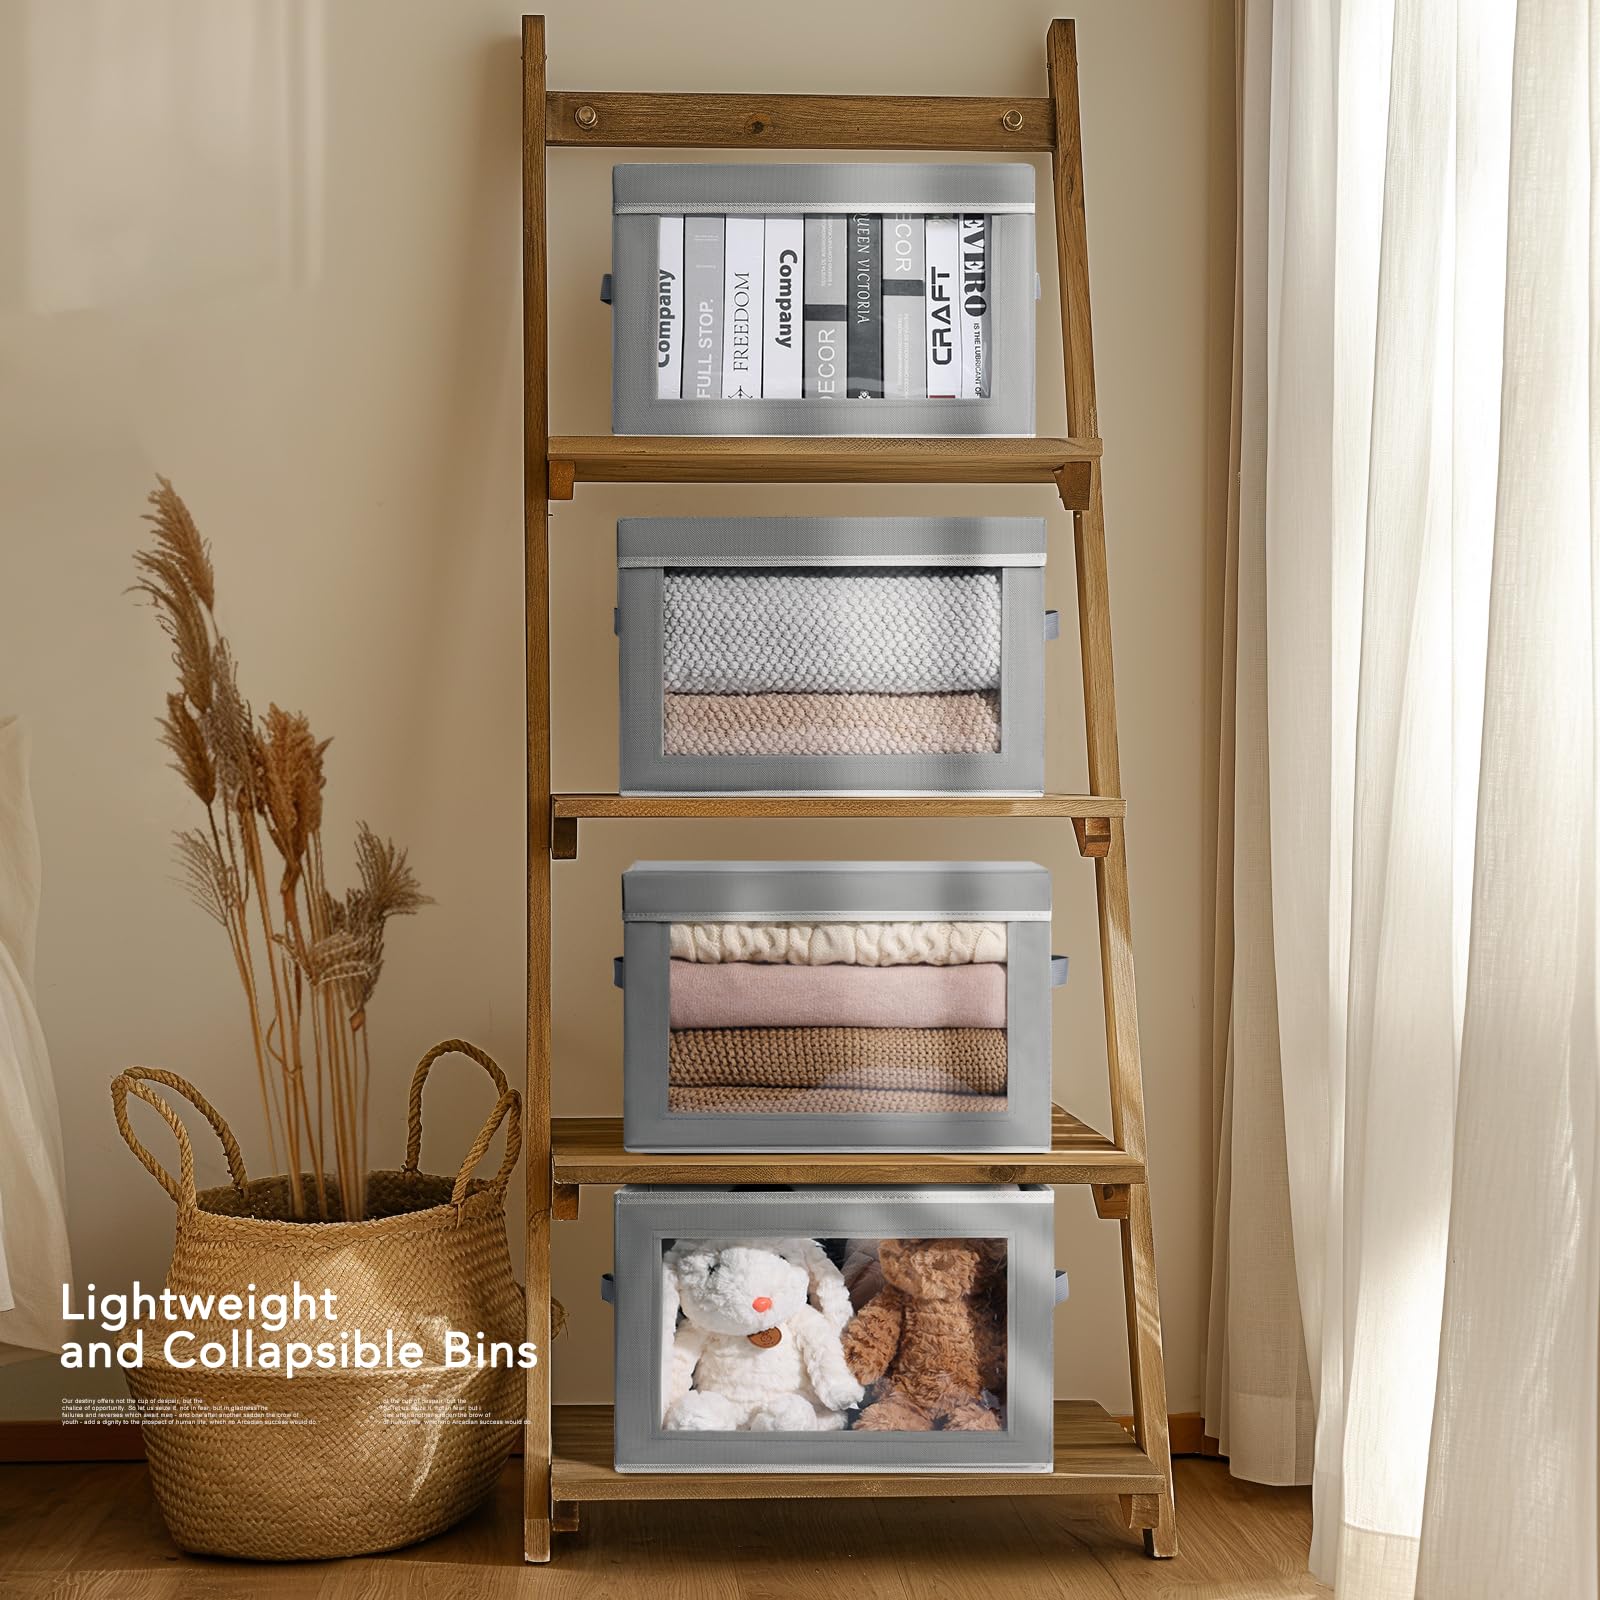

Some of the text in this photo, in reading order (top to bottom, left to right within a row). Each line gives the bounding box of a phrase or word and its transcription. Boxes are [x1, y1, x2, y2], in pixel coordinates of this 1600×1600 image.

[733, 271, 750, 372] FREEDOM
[775, 249, 797, 349] Company
[856, 258, 871, 324] VICTORIA
[931, 266, 952, 365] CRAFT
[973, 322, 980, 330] IS
[696, 298, 714, 399] FULL STOP.
[974, 345, 982, 385] LUBRICANT
[975, 386, 982, 397] OF
